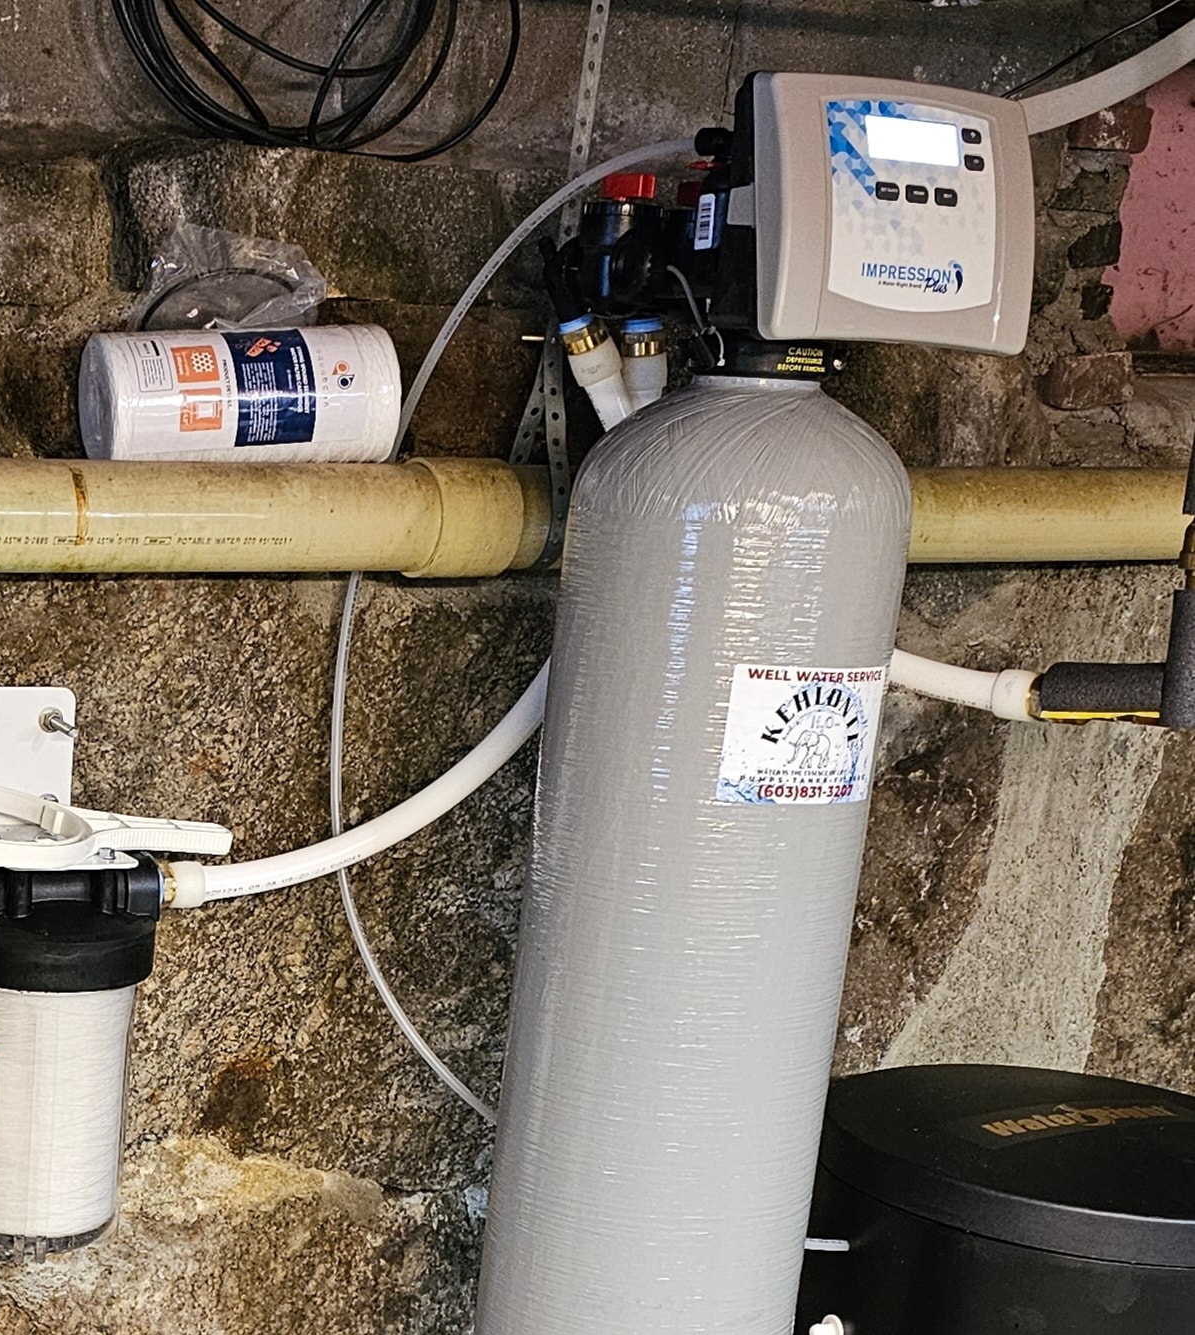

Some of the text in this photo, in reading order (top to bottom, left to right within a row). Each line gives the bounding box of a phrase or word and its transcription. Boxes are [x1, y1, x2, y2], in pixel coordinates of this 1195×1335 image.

[861, 262, 951, 285] IMPRESSION
[923, 276, 948, 294] Plus
[787, 346, 824, 357] CAUTION
[748, 668, 882, 683] WELL WATER SERVICE
[757, 784, 853, 801] (603)831-3207
